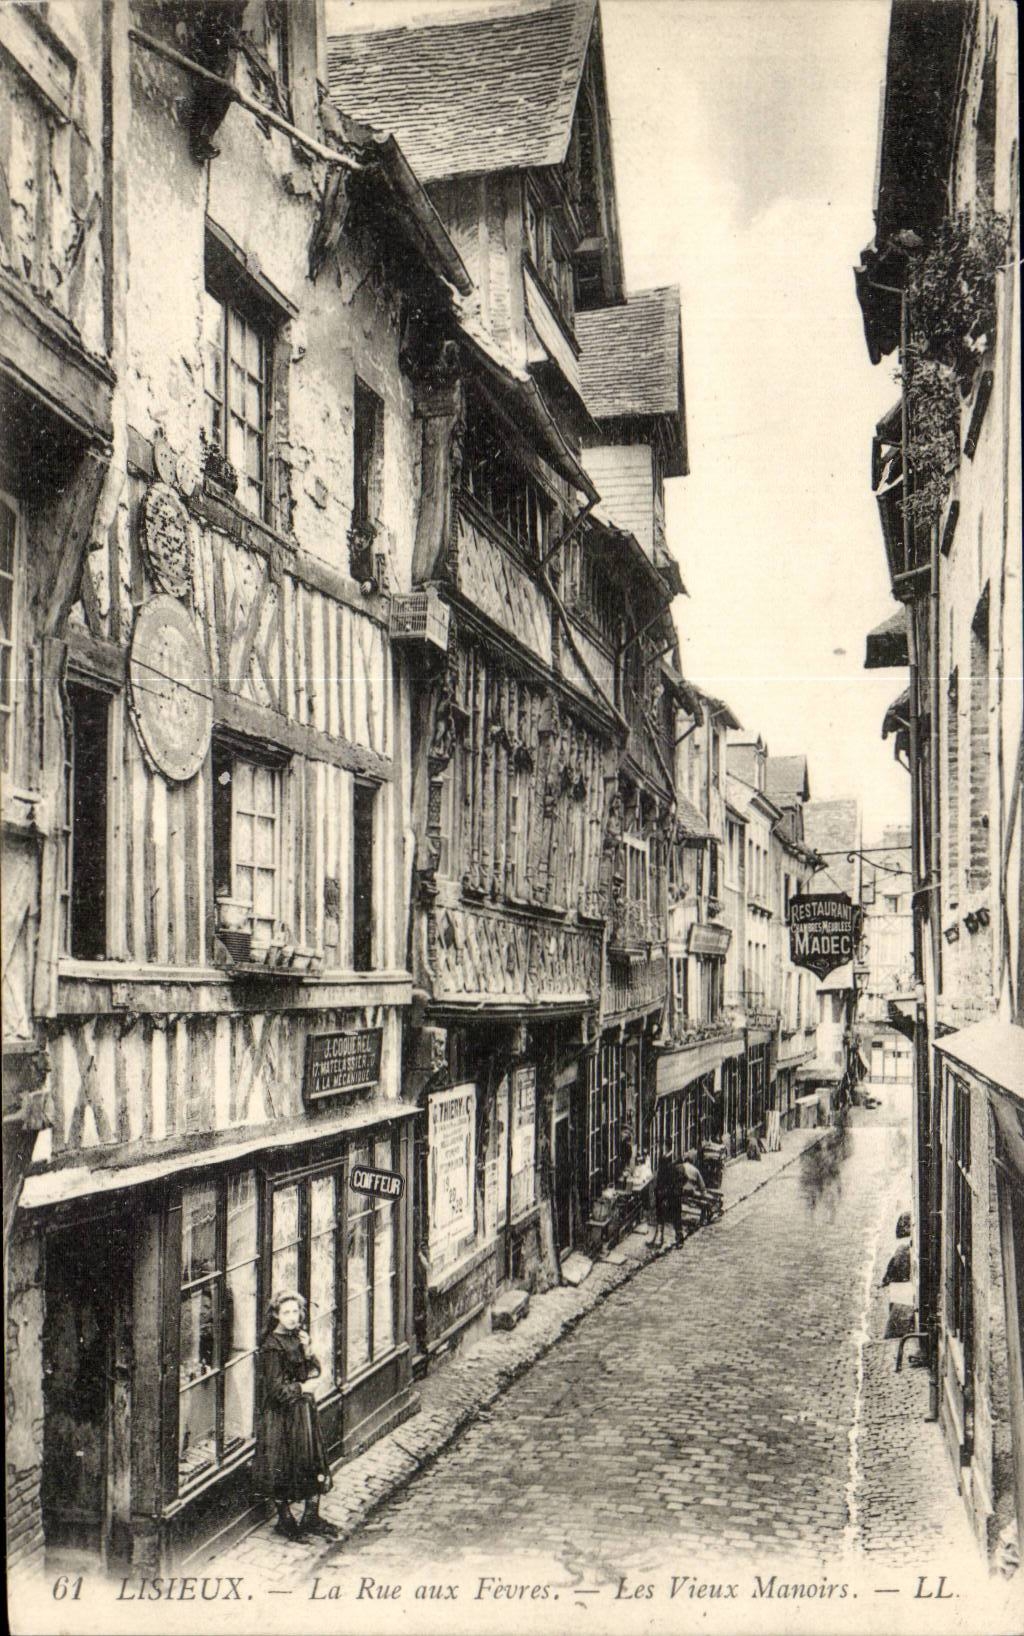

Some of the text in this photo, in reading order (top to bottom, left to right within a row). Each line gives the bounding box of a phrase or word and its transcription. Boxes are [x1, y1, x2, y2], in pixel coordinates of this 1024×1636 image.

[791, 901, 852, 921] RESTAURANT
[795, 934, 851, 956] MADEC
[322, 1076, 331, 1091] LA
[354, 1170, 401, 1195] COIFFEUR
